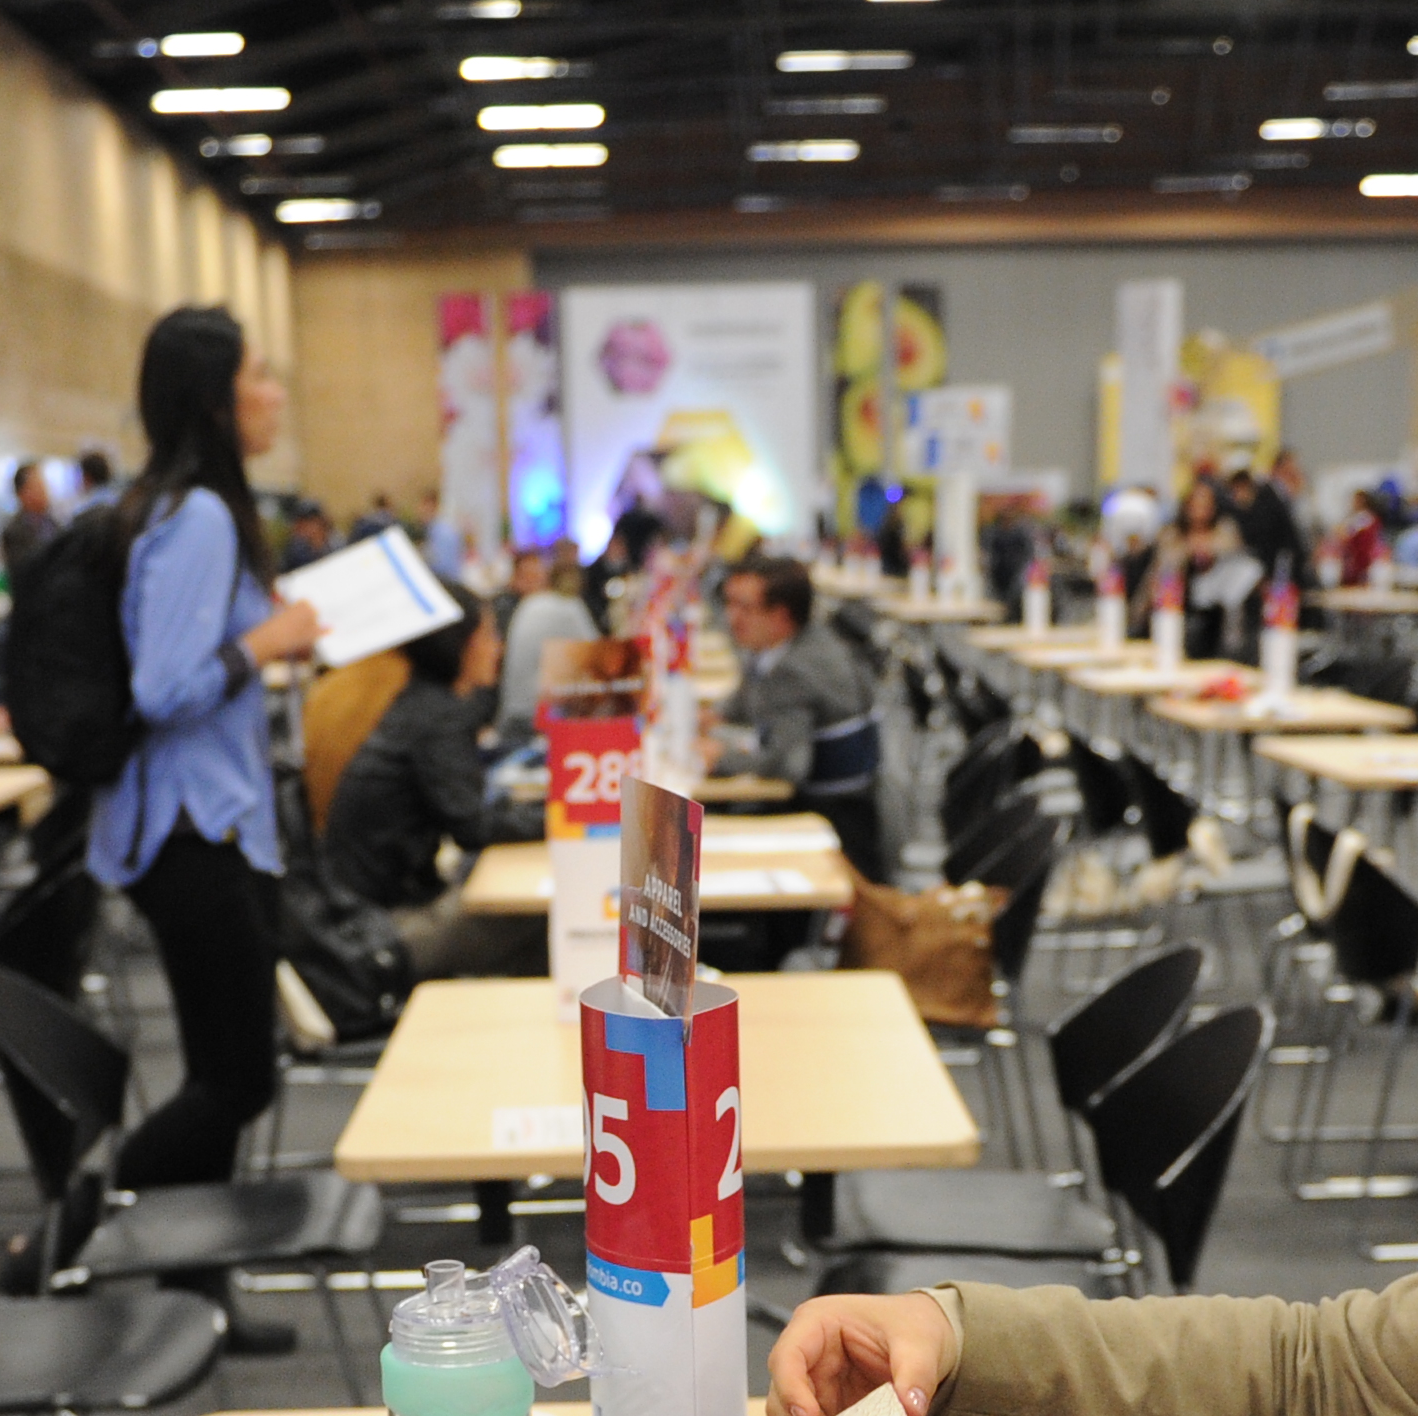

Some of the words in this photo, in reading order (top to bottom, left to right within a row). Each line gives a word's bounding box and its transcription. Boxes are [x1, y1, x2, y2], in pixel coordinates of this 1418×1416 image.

[643, 873, 683, 918] APPAREL
[628, 903, 648, 928] AND
[649, 914, 692, 959] ACCESSORIES
